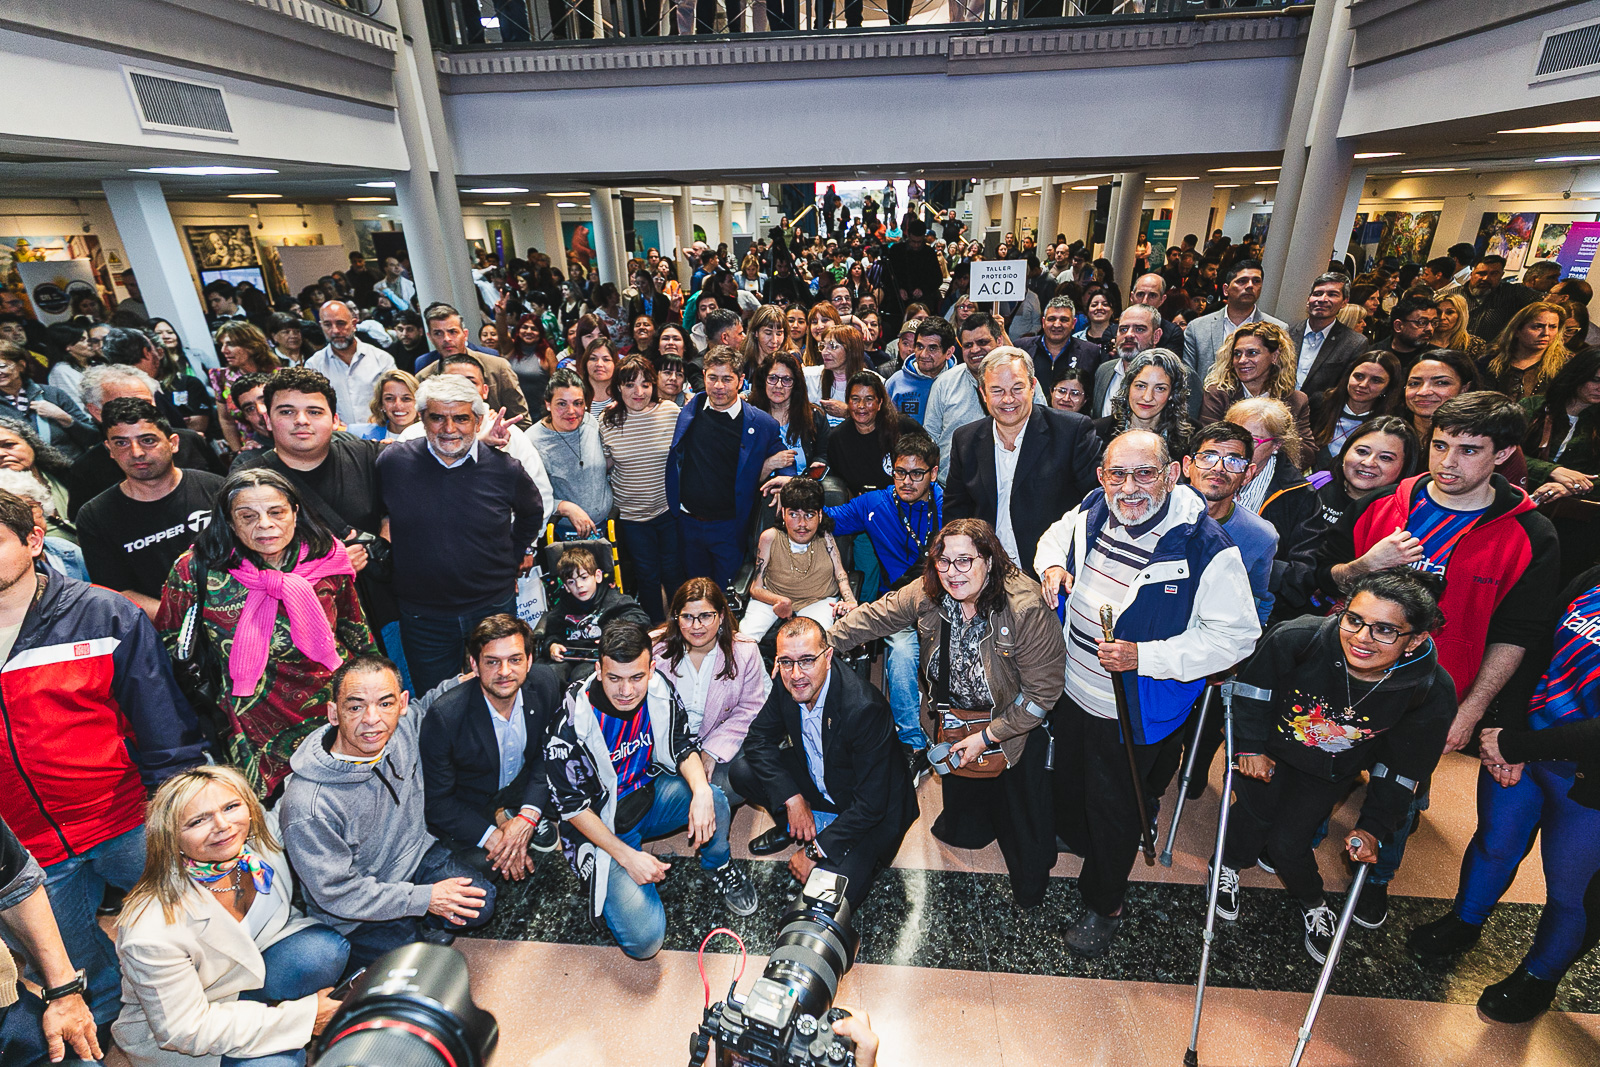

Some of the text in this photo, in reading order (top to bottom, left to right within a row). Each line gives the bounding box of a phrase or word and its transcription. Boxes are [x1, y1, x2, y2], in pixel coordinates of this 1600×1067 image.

[978, 281, 1016, 295] A.C.D.
[124, 524, 184, 552] TOPPER
[516, 598, 538, 609] rupo
